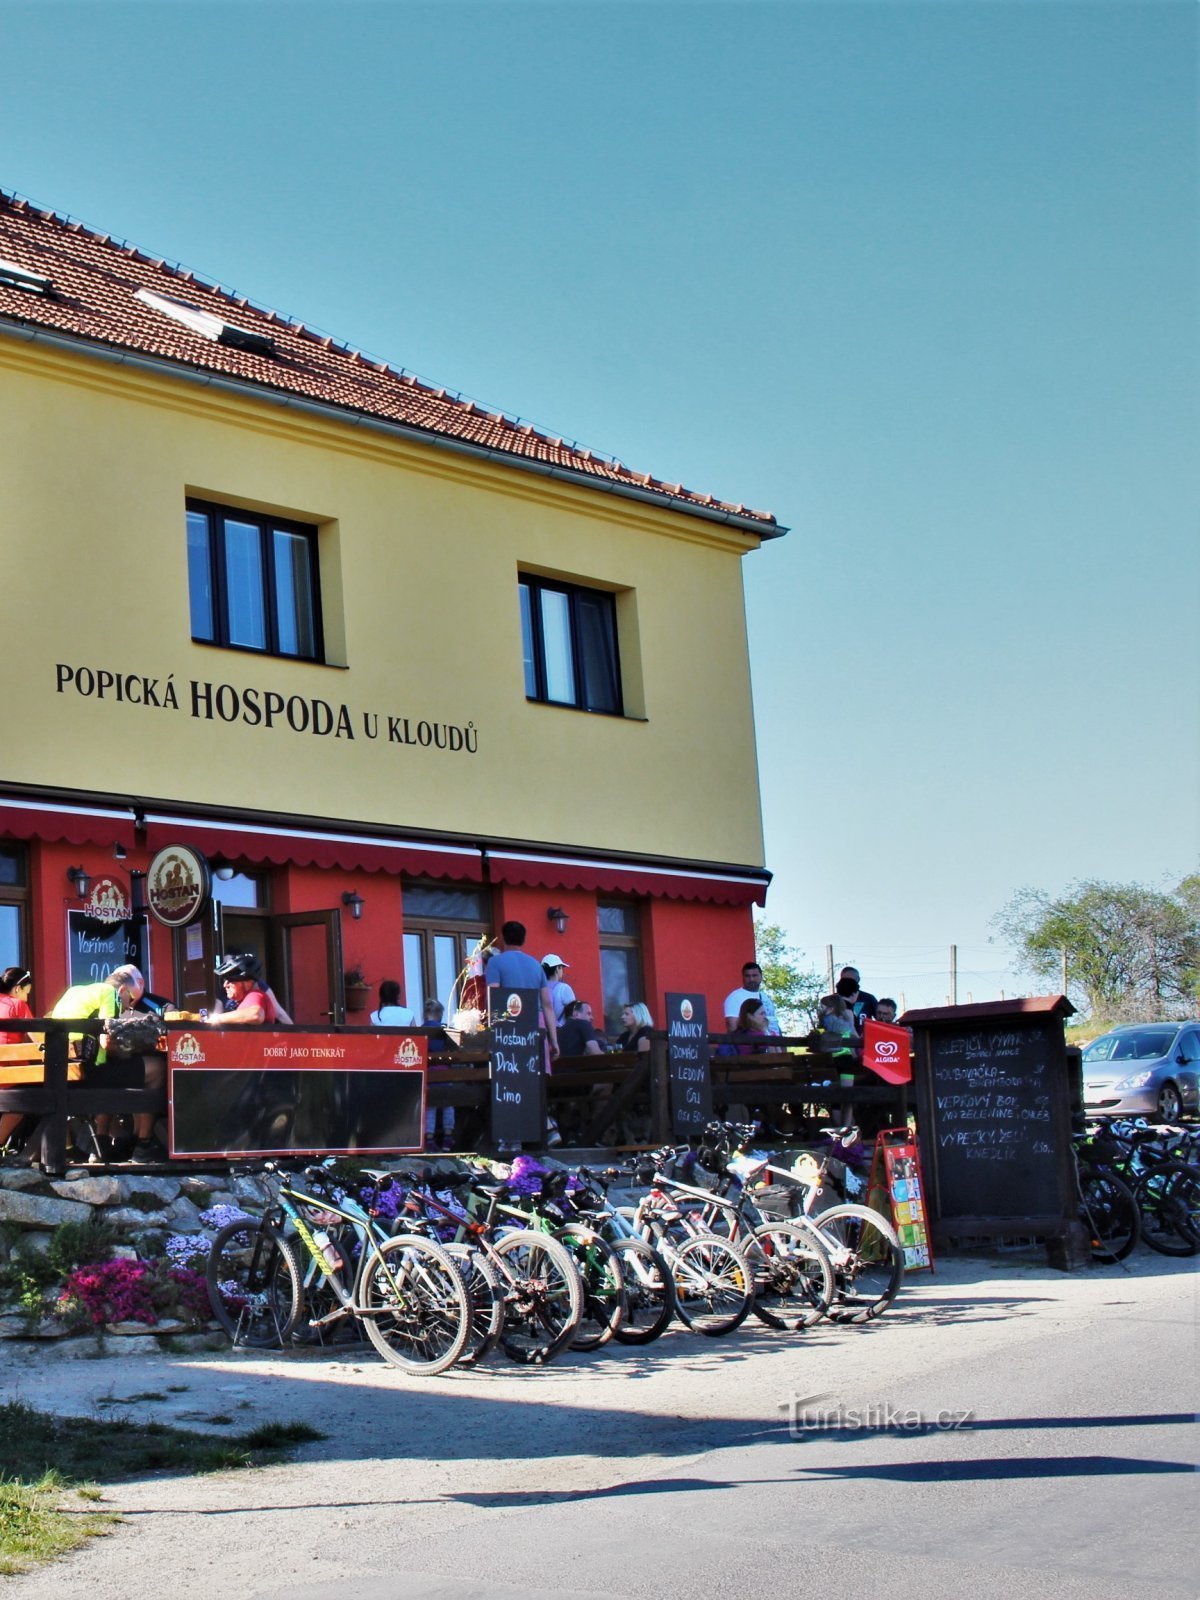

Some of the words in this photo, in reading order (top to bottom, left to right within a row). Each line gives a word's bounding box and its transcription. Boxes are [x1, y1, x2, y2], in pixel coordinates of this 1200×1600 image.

[55, 663, 180, 710] POPICKÁ
[189, 680, 355, 741] HOSPODA
[363, 712, 379, 740] U
[388, 716, 480, 754] KLOUDŮ
[150, 884, 200, 903] HOSTAN
[84, 902, 133, 920] HOSTAN
[122, 936, 137, 957] do
[495, 1027, 527, 1047] Hostan
[171, 1051, 205, 1062] HOSTAN
[263, 1046, 287, 1057] DOBRÝ
[289, 1047, 309, 1059] JAKO
[310, 1046, 345, 1058] TENKRÁT
[394, 1054, 423, 1065] HOSTAN
[495, 1051, 520, 1074] Drak
[496, 1082, 522, 1105] Limo
